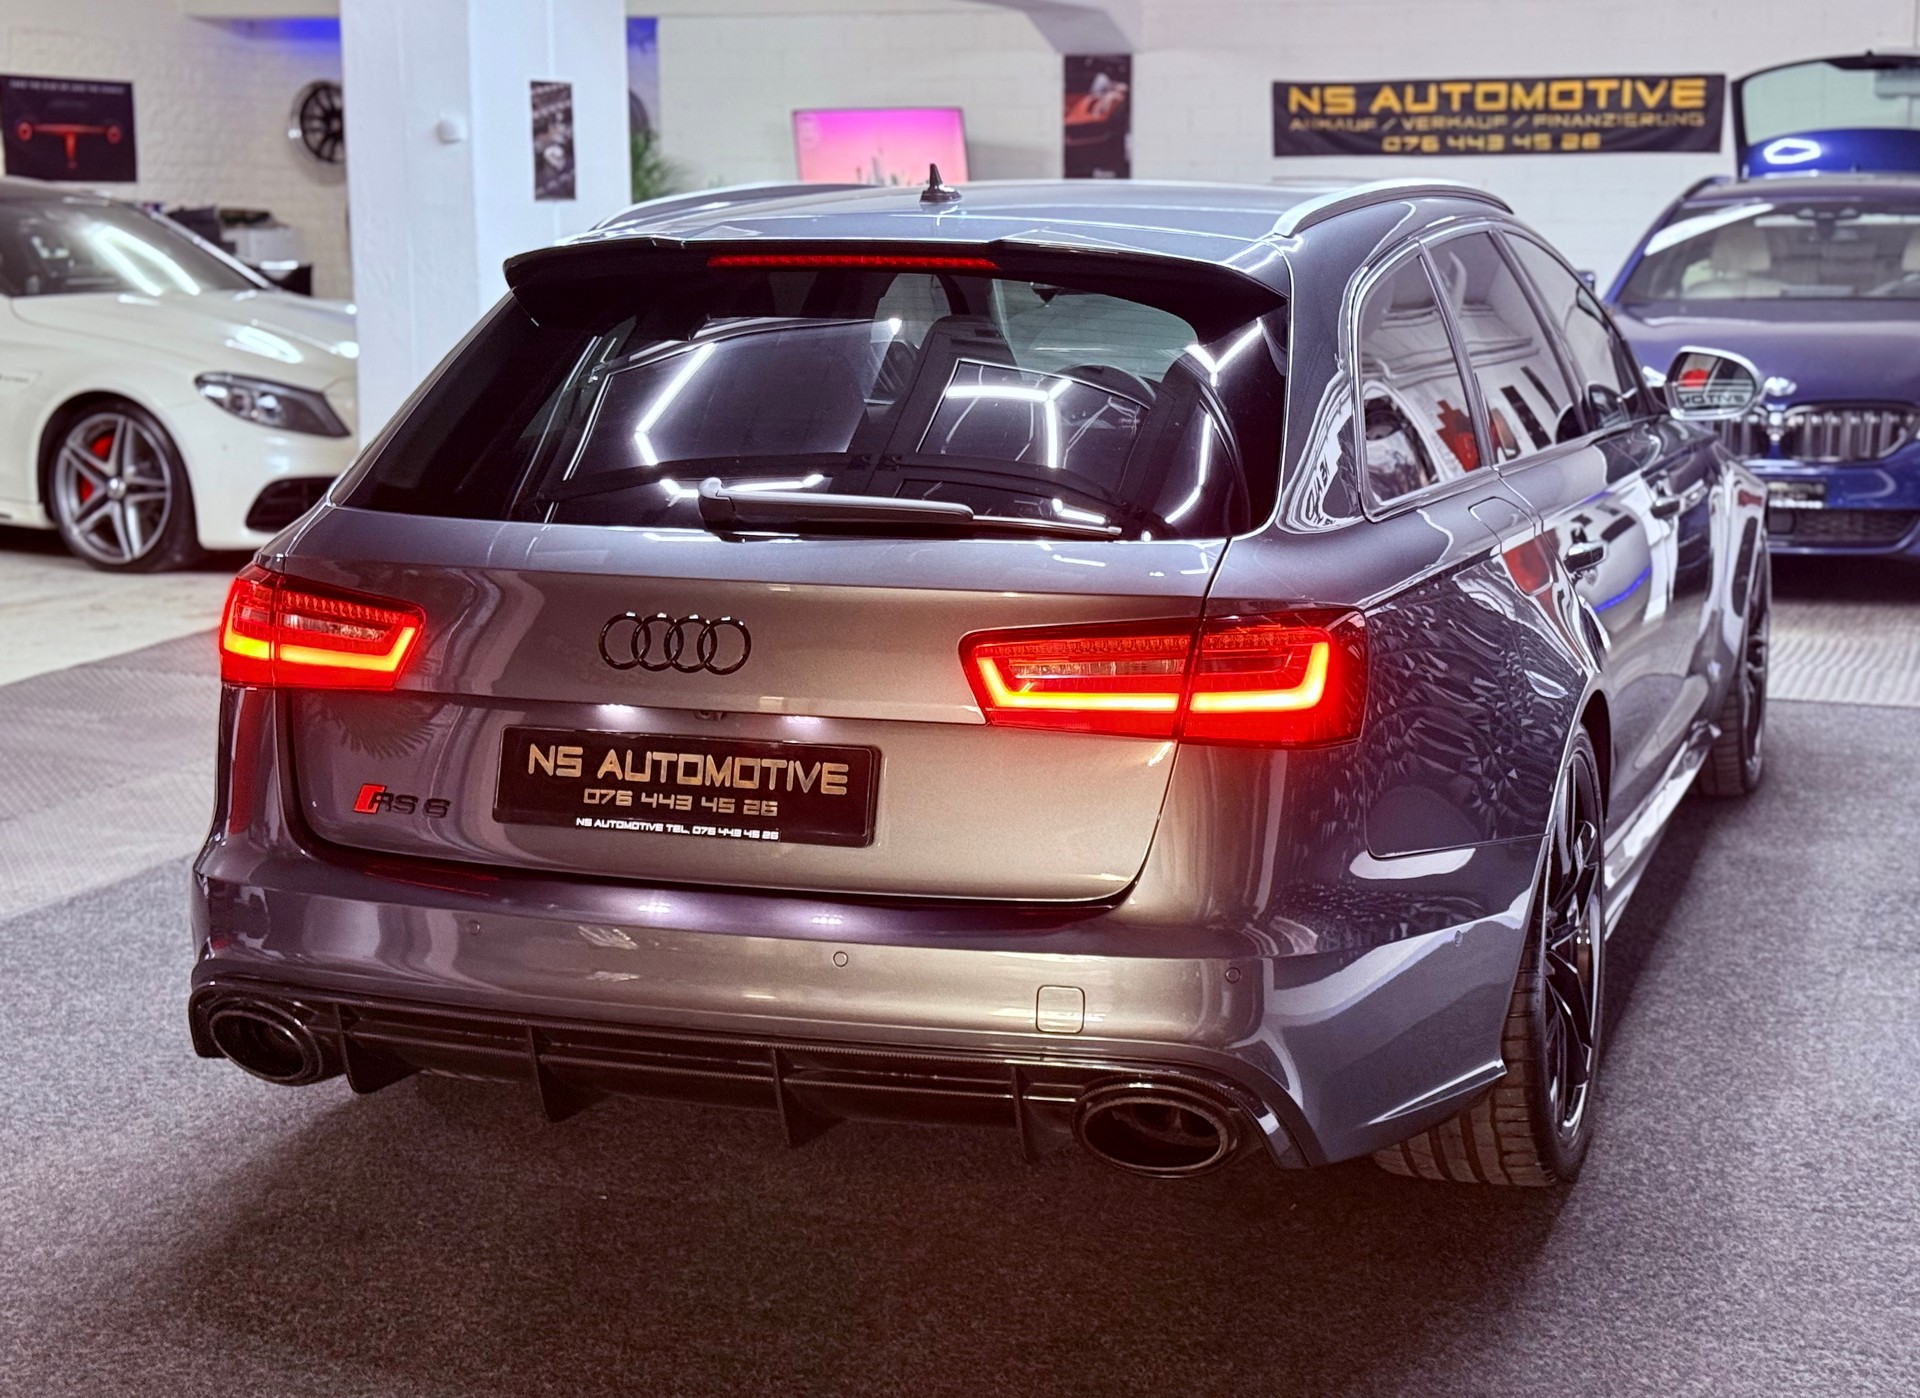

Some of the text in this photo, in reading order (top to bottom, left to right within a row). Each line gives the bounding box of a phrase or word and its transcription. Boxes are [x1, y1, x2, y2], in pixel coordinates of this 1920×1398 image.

[1288, 78, 1707, 114] NS AUTOMOTIVE
[1402, 114, 1508, 130] VERKAUF
[1532, 112, 1706, 128] FINANZIERUNG
[1382, 135, 1440, 152] 076
[1446, 134, 1505, 152] 443
[1512, 134, 1552, 151] 45
[528, 743, 849, 796] NS AUTOMOTIVE
[422, 798, 451, 818] 6
[583, 788, 778, 817] 076 443 45 26
[576, 817, 593, 828] NS
[594, 819, 664, 833] AUTOMOTIVE
[692, 826, 717, 836] 076
